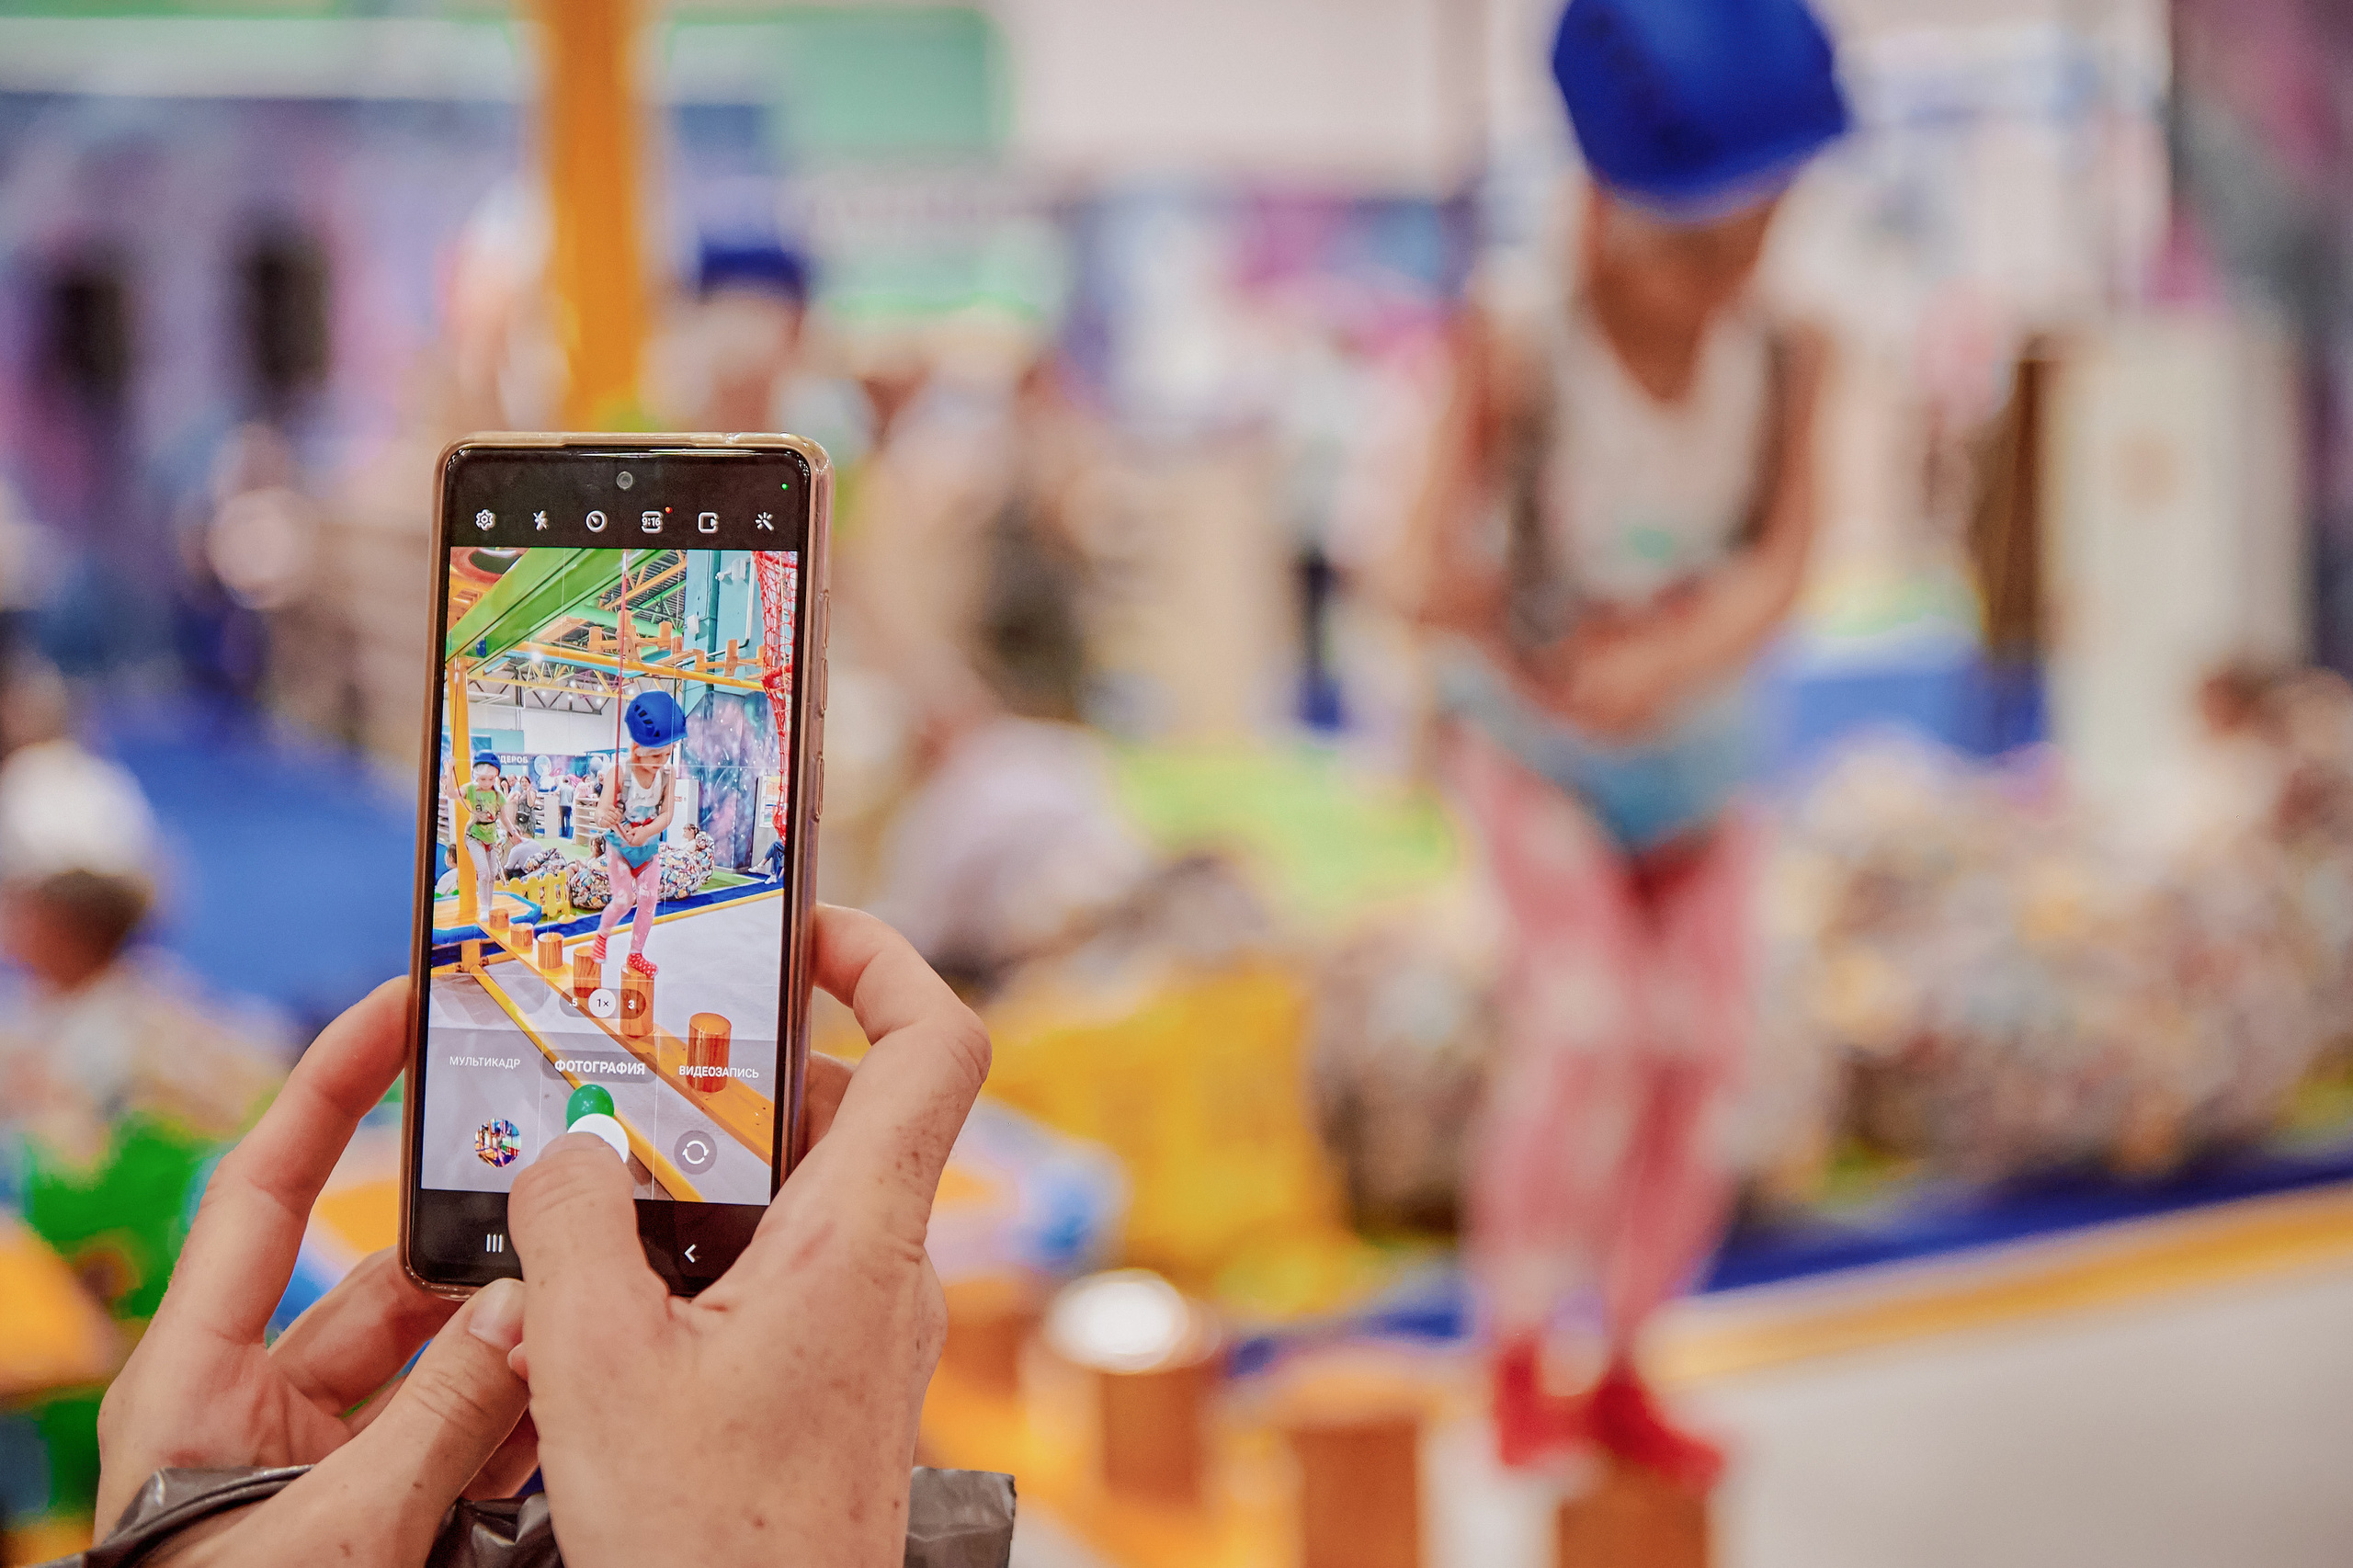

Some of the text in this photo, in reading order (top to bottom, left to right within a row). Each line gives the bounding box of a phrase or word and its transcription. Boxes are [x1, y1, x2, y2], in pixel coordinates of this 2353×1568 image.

[642, 517, 662, 528] 9:16
[497, 755, 529, 765] ДЕРОБ
[628, 999, 635, 1010] 3
[449, 1056, 759, 1079] МУЛЬТИКАДР ФОТОГРАФИЯ ВИДЕОЗАПИСЬ
